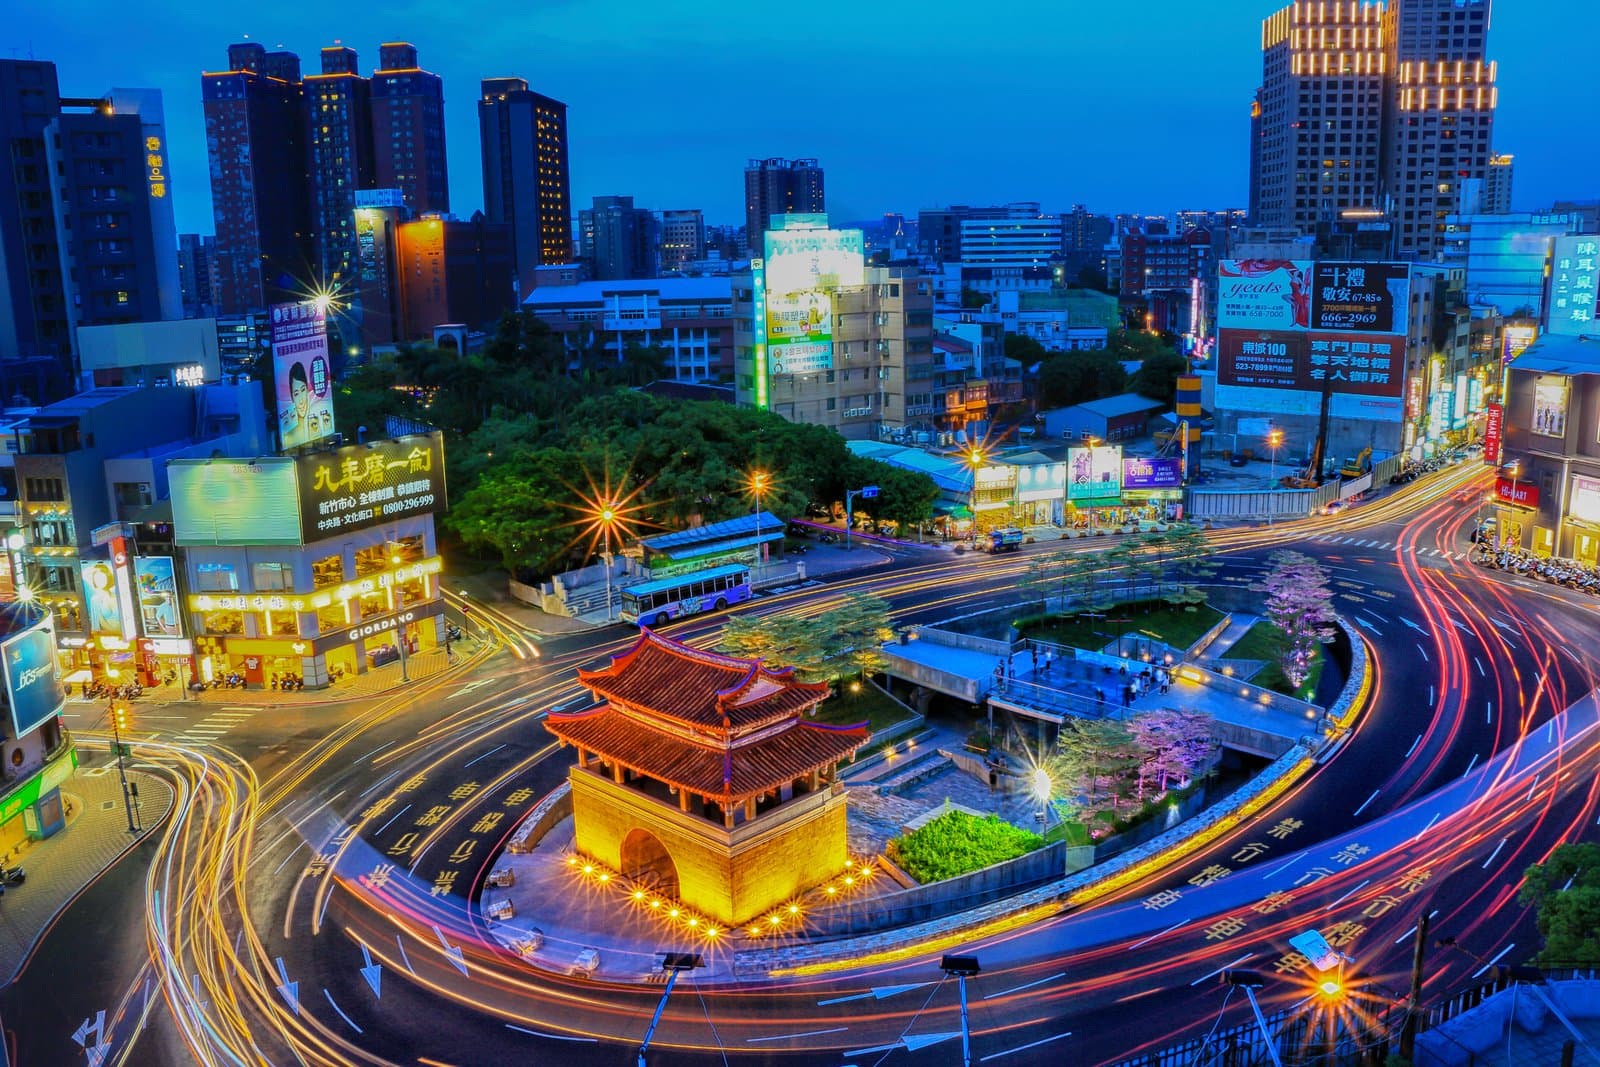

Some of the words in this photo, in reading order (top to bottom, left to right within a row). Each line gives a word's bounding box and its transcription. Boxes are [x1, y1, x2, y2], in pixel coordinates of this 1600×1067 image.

[1309, 369, 1389, 384] 名人御所
[319, 496, 357, 515] 新竹市心
[349, 612, 414, 640] GIORDANO
